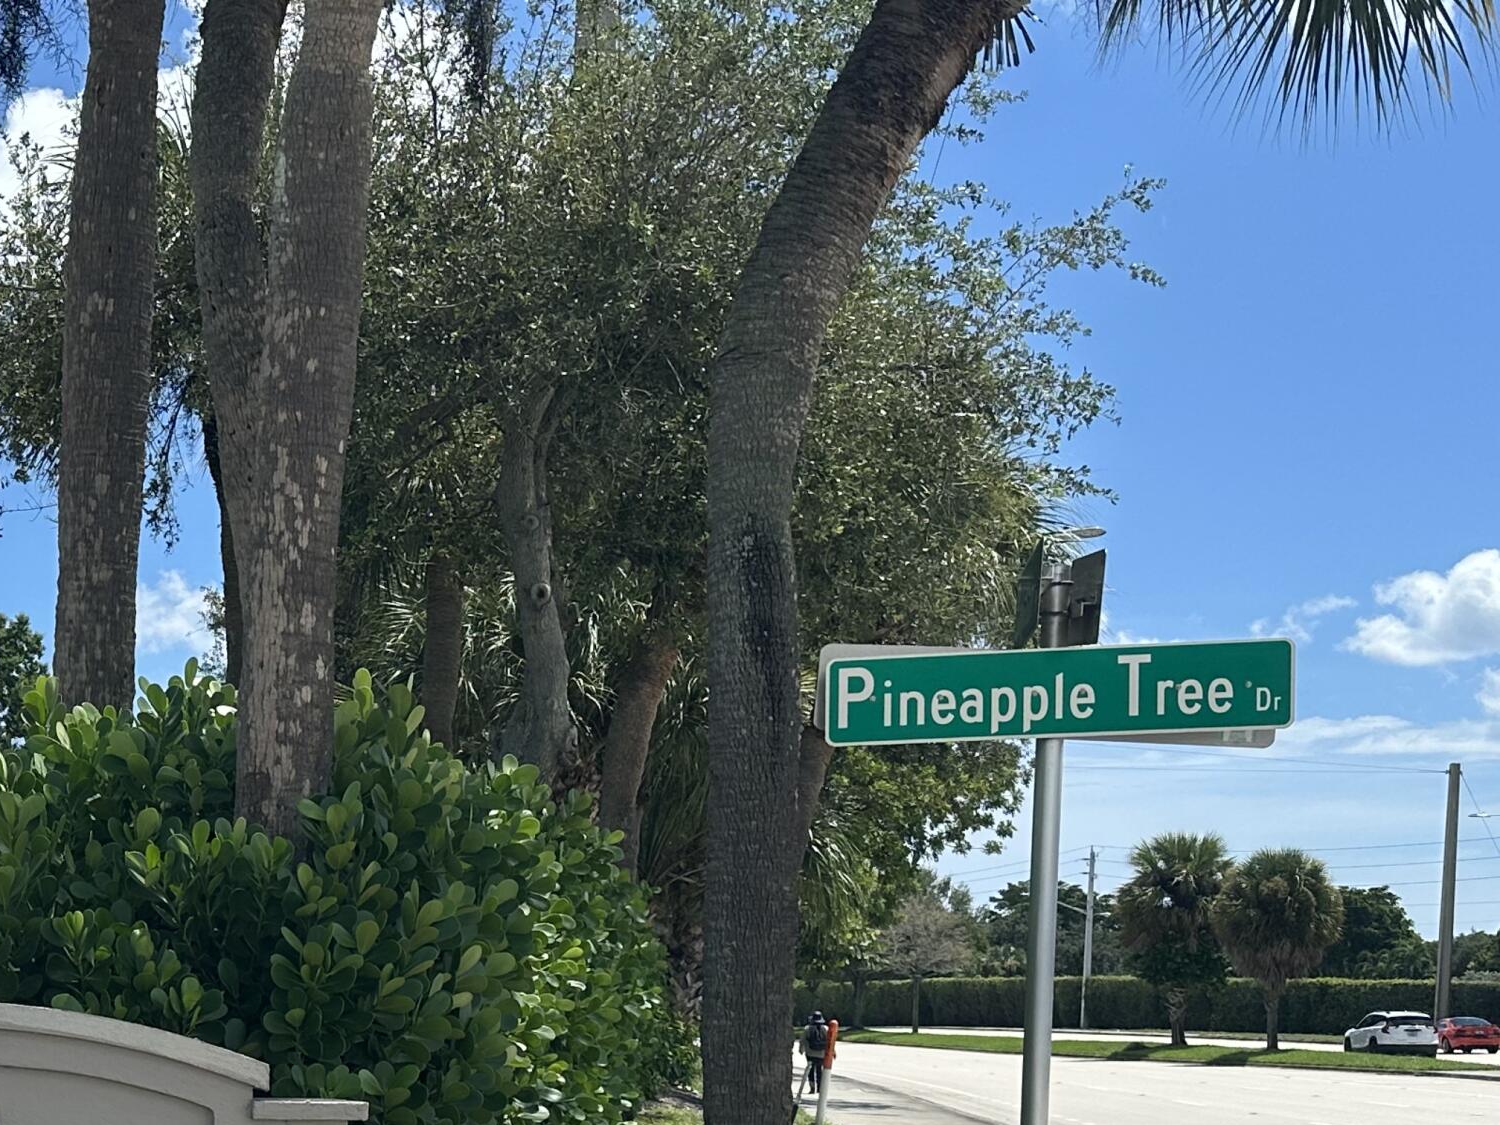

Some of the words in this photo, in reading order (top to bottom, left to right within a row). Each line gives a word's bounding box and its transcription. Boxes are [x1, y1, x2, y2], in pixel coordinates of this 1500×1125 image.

[837, 666, 1095, 734] Pineapple
[1117, 653, 1234, 718] Tree
[1256, 686, 1282, 712] Dr
